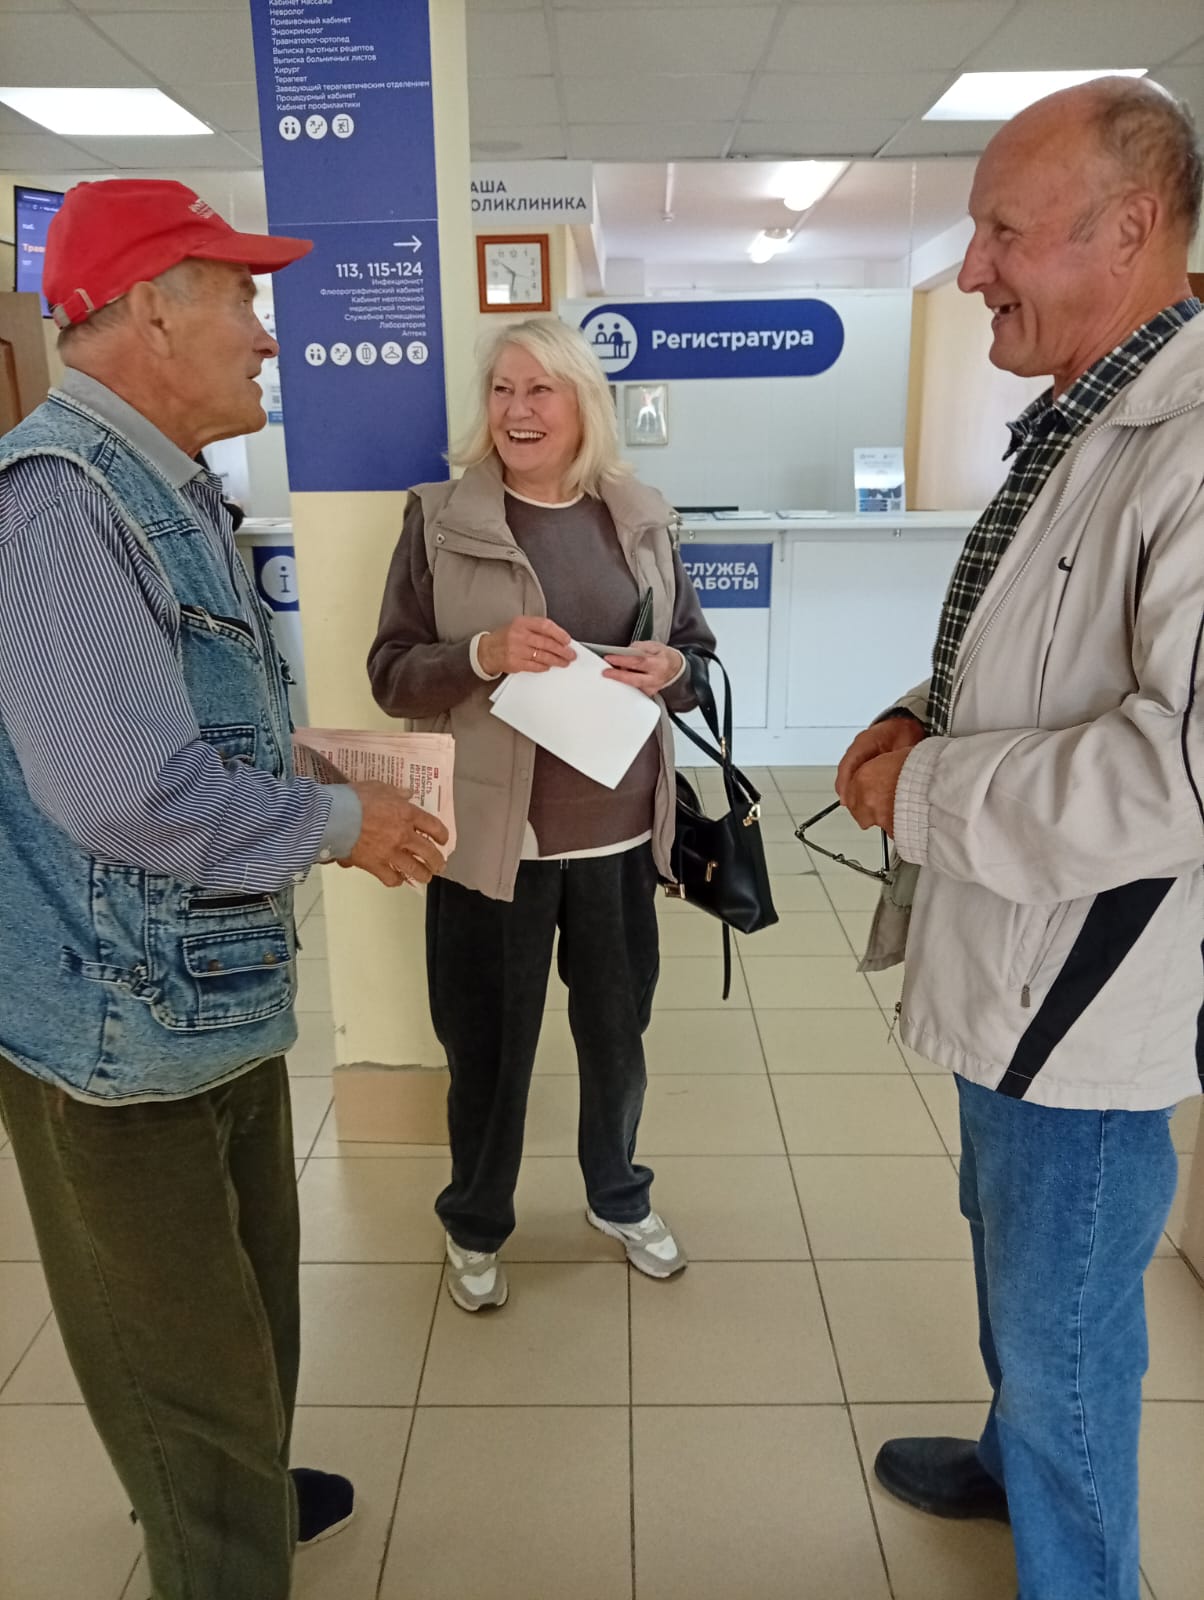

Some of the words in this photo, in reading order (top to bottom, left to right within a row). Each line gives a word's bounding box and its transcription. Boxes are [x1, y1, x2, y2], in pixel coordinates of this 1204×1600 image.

[270, 8, 304, 16] Невролог
[270, 17, 320, 26] Прививочный
[322, 16, 351, 24] кабинет
[271, 27, 323, 36] Эндокринолог
[272, 47, 304, 55] Выписка
[339, 45, 374, 53] рецептов
[306, 55, 349, 63] больничных
[351, 54, 377, 62] листов
[274, 66, 300, 75] Хирург
[275, 75, 307, 83] Терапевт
[275, 84, 321, 93] Заведующий
[323, 82, 385, 90] терапевтическим
[386, 80, 430, 89] отделением
[276, 93, 325, 103] Процедурный
[327, 91, 356, 99] кабинет
[277, 103, 307, 111] Кабинет
[308, 101, 360, 110] профилактики
[470, 180, 507, 193] АША
[471, 197, 587, 212] ОЛИКЛИНИКА
[336, 263, 363, 279] 113,
[367, 261, 423, 277] 115-124
[371, 278, 424, 286] Инфекционист
[379, 321, 426, 329] Лаборатория
[652, 329, 814, 351] Регистратура
[683, 562, 759, 576] СЛУЖБА
[692, 576, 759, 590] АБОТЫ
